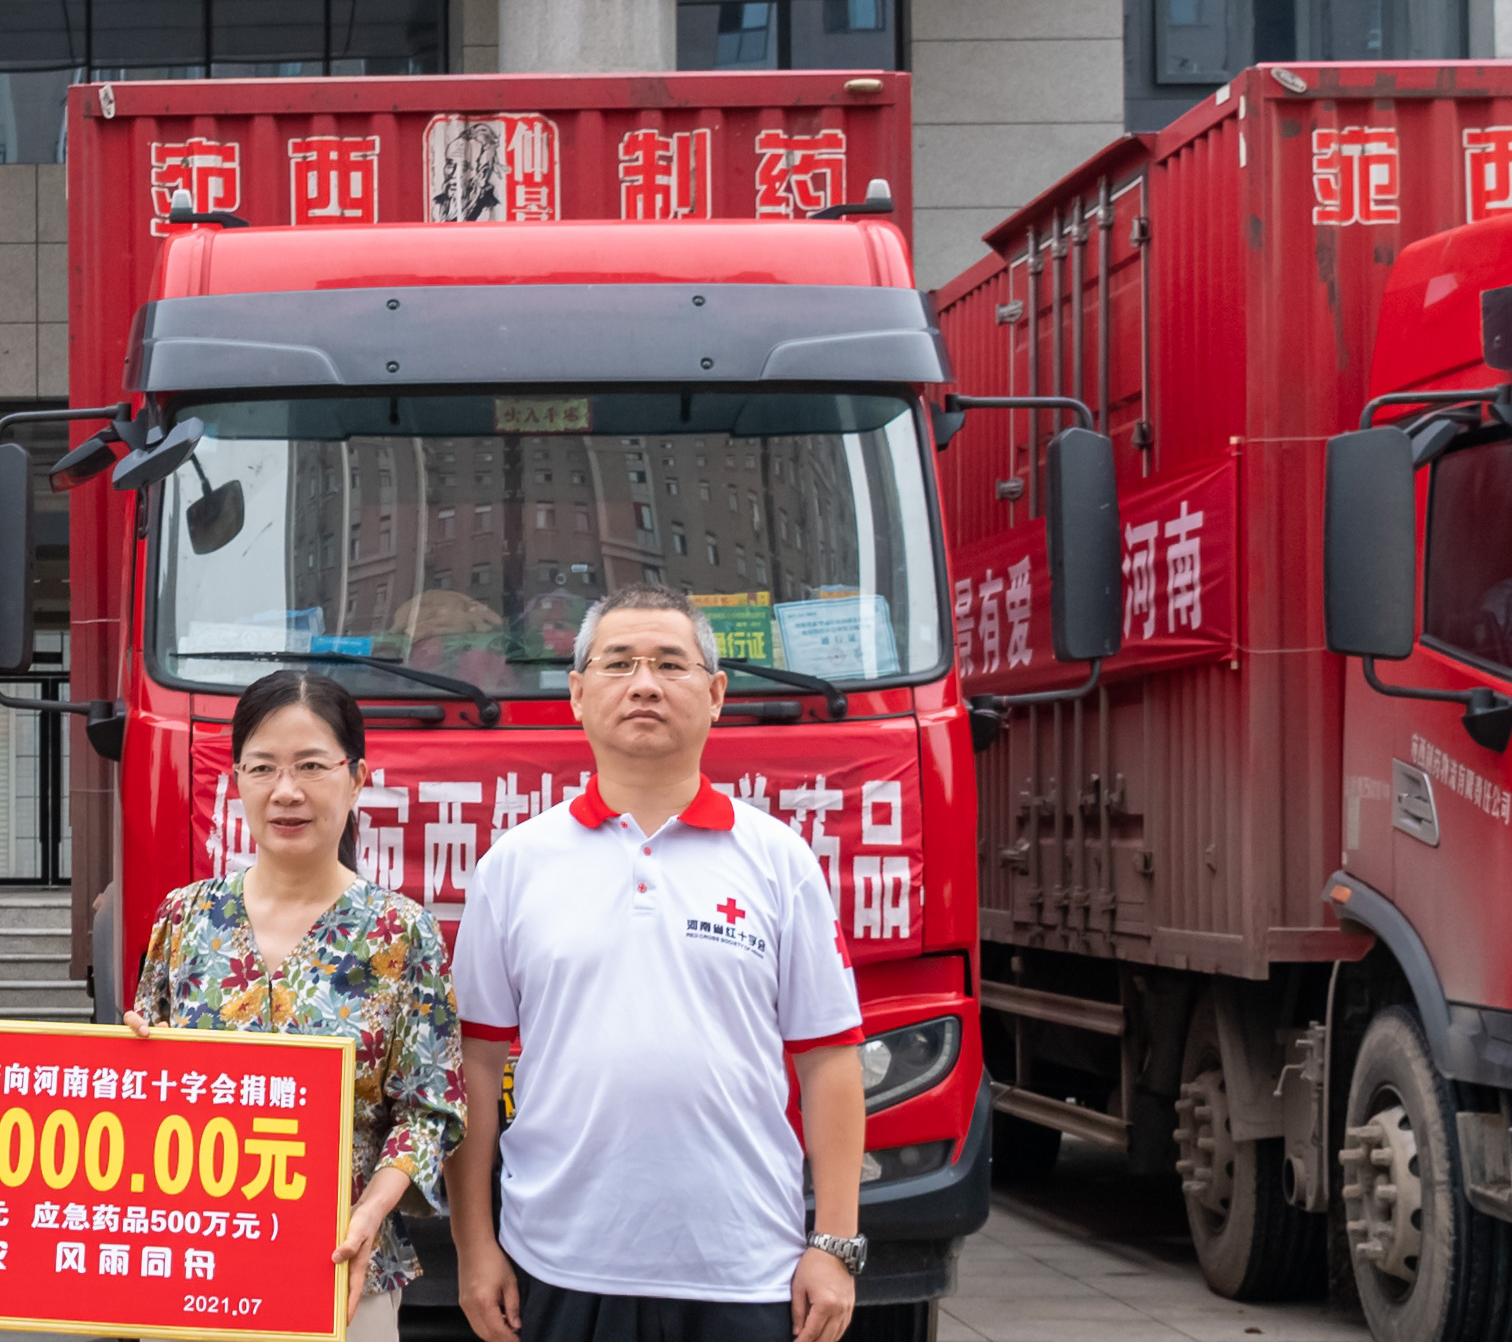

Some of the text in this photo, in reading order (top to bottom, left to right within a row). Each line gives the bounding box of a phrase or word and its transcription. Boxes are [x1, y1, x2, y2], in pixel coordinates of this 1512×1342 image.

[1121, 500, 1204, 641] 河南
[54, 1241, 217, 1281] 风雨同舟
[183, 1294, 263, 1317] 2021.07
